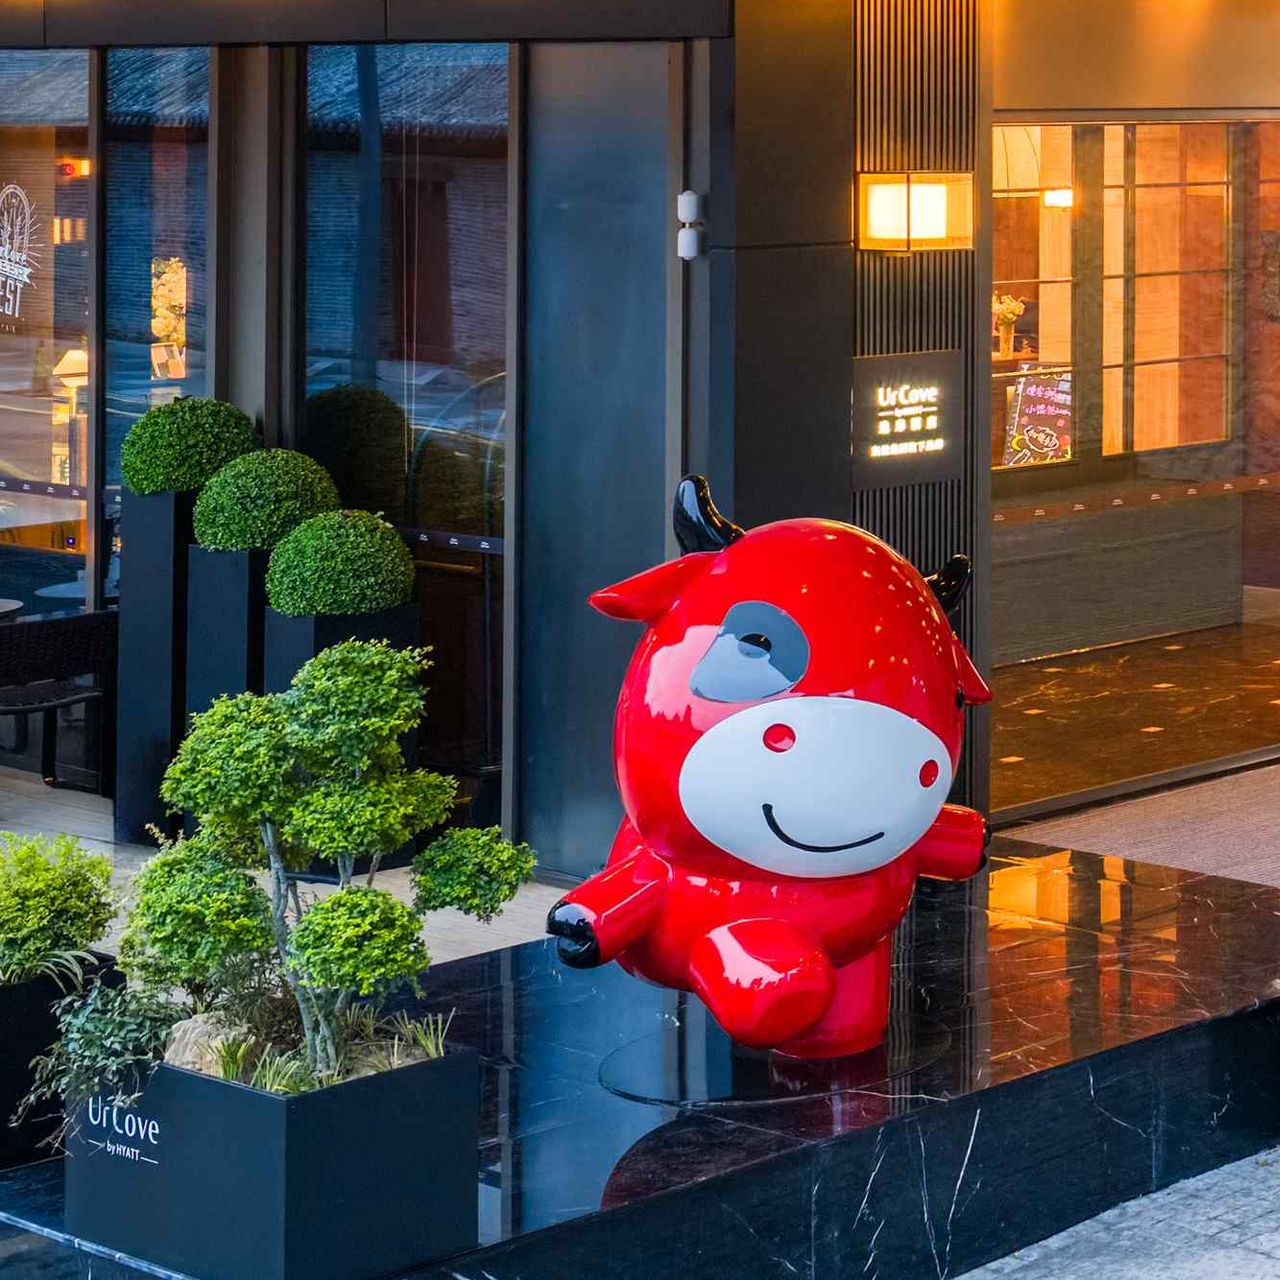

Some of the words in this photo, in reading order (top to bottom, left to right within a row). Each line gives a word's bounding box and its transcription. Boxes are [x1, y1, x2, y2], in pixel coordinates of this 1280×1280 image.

[877, 384, 939, 407] UrCove
[106, 1139, 116, 1156] by
[116, 1142, 141, 1161] HYATT
